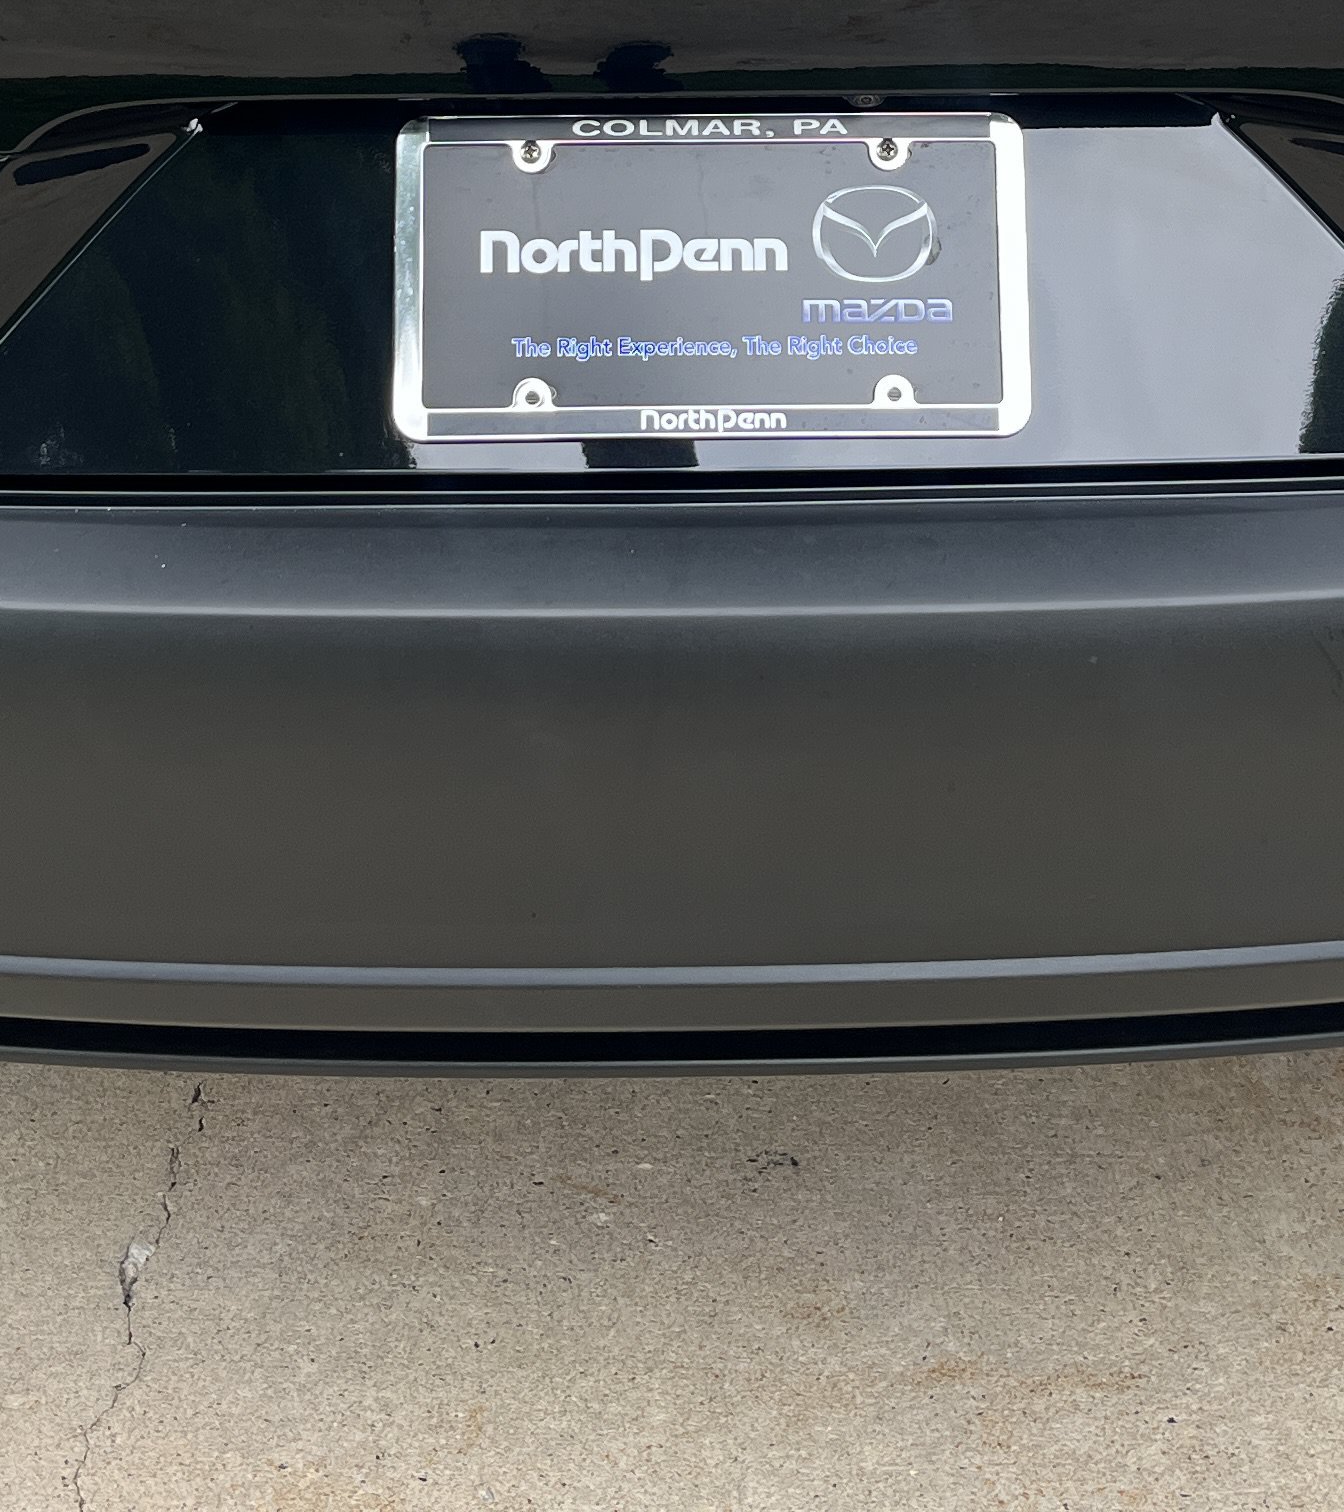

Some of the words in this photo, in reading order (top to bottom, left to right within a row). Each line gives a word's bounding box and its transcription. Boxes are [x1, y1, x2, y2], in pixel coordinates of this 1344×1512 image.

[571, 118, 775, 138] COLMAR,
[792, 118, 849, 135] PA
[479, 229, 789, 282] NorthPenn
[511, 337, 552, 358] The
[556, 336, 613, 362] Right
[617, 336, 738, 361] Experience,
[741, 336, 783, 356] The
[787, 335, 843, 359] Right
[847, 335, 920, 356] Choice
[640, 407, 788, 433] NorthPenn
